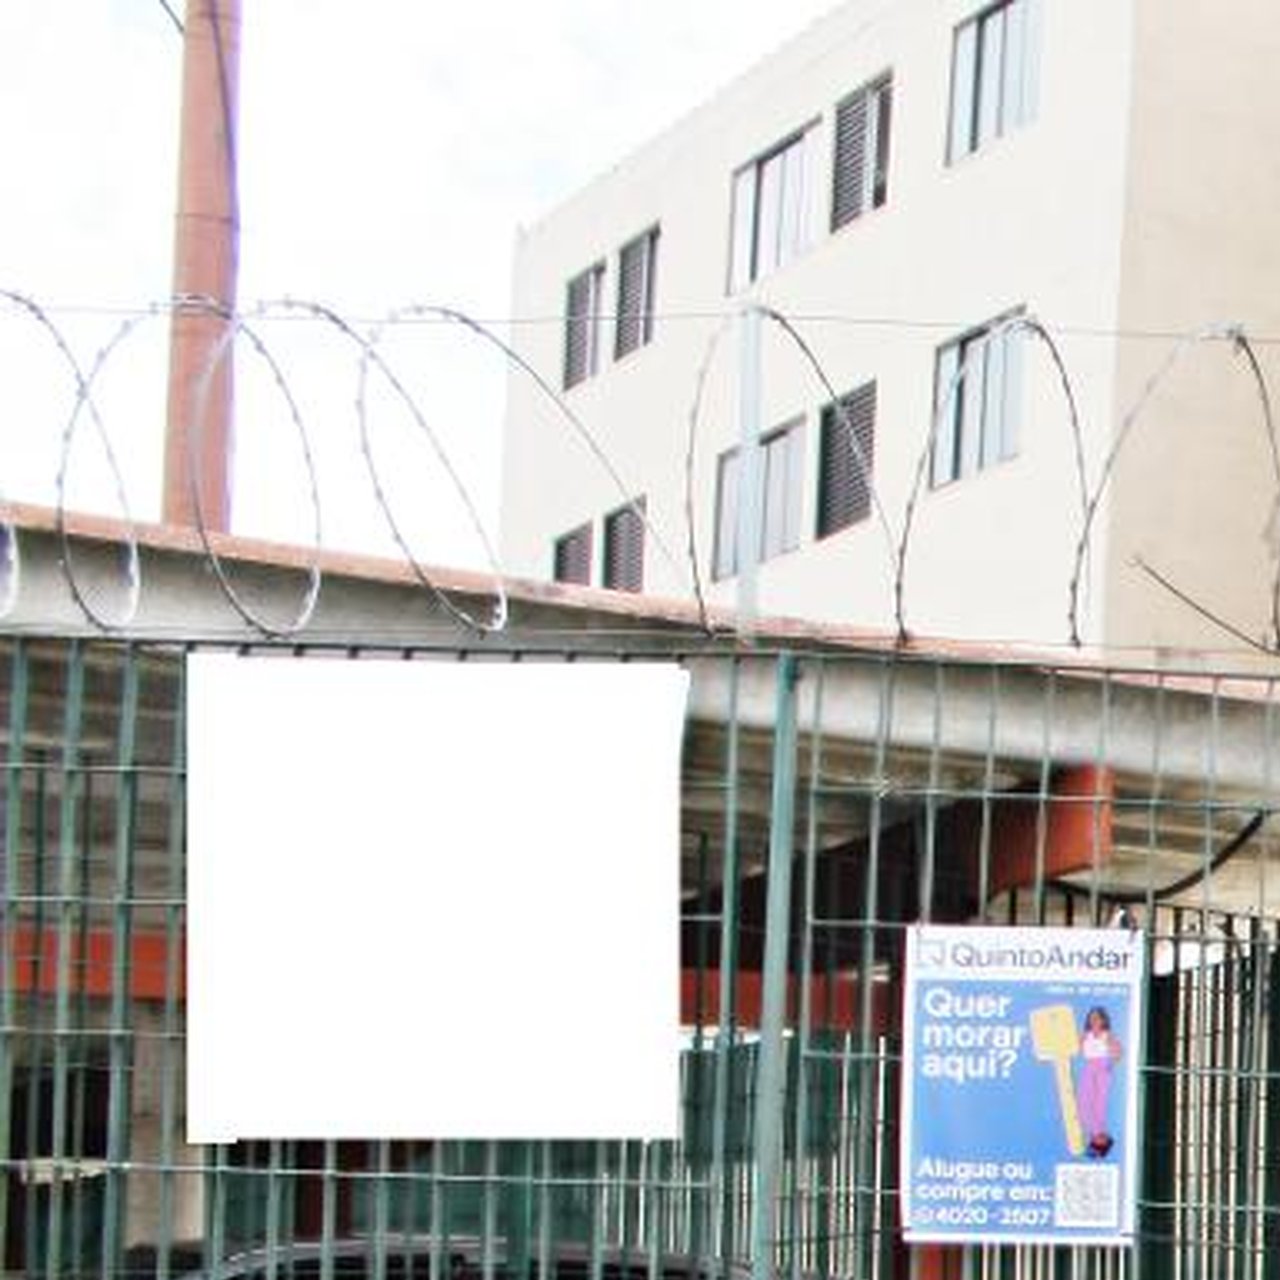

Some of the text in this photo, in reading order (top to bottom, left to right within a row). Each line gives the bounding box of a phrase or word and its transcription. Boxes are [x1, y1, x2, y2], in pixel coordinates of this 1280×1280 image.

[951, 943, 1133, 970] QuintoAndar
[924, 987, 1013, 1018] Quer
[922, 1023, 1027, 1048] morar
[921, 1050, 1018, 1084] aqui?
[916, 1157, 1033, 1184] Alugue ou
[915, 1184, 1005, 1204] compre
